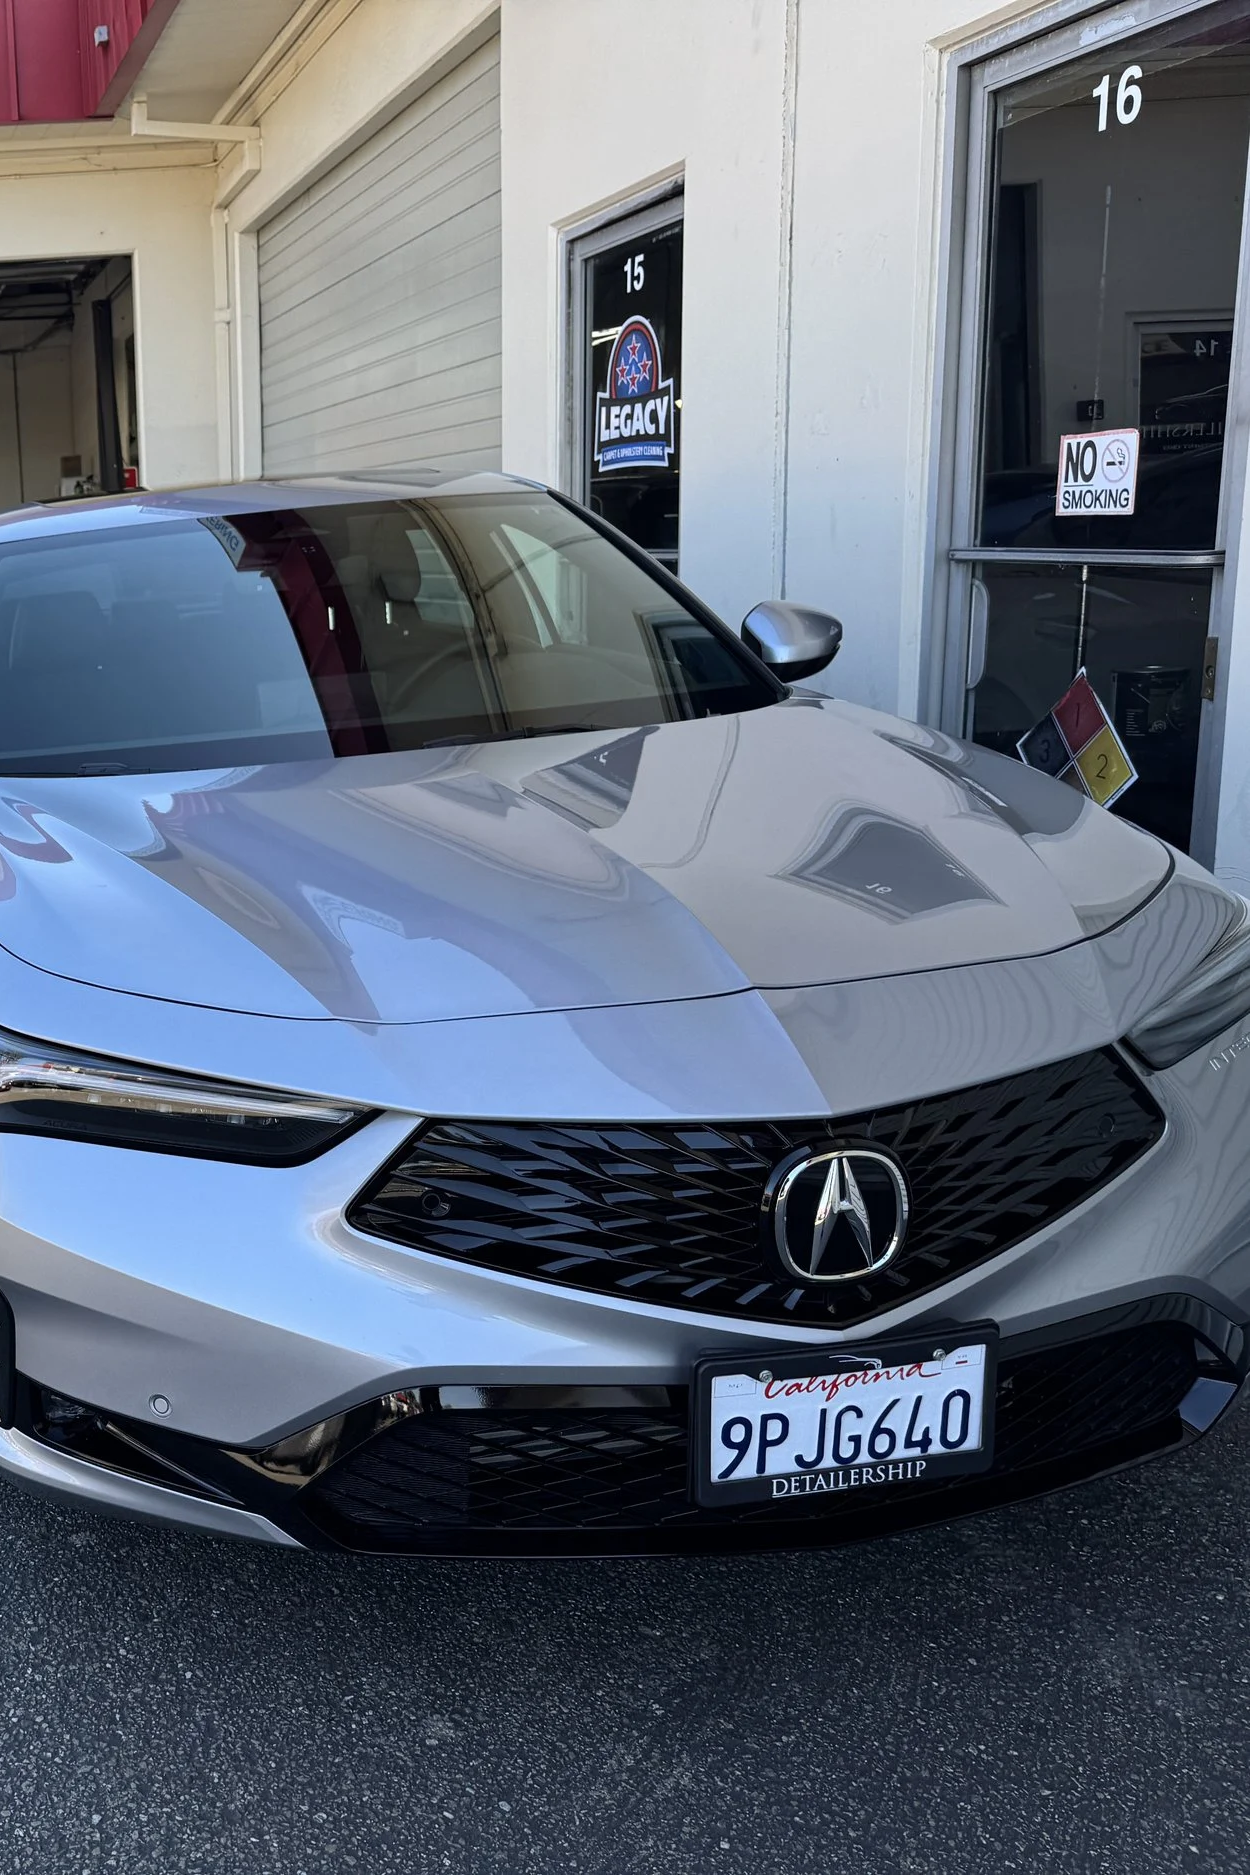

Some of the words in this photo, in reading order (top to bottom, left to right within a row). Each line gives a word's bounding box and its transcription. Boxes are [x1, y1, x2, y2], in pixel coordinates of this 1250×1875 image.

[1093, 65, 1143, 132] 16
[623, 253, 645, 293] 15
[600, 395, 669, 442] LEGACY
[603, 449, 617, 461] CARPET
[644, 446, 663, 456] CLEANING
[1064, 440, 1097, 483] NO
[1062, 488, 1130, 509] SMOKING
[1039, 739, 1050, 763] 3
[1095, 753, 1108, 779] 2
[763, 1362, 942, 1402] California
[717, 1388, 972, 1480] 9PJG640
[772, 1460, 927, 1498] DETAILERSHIP
